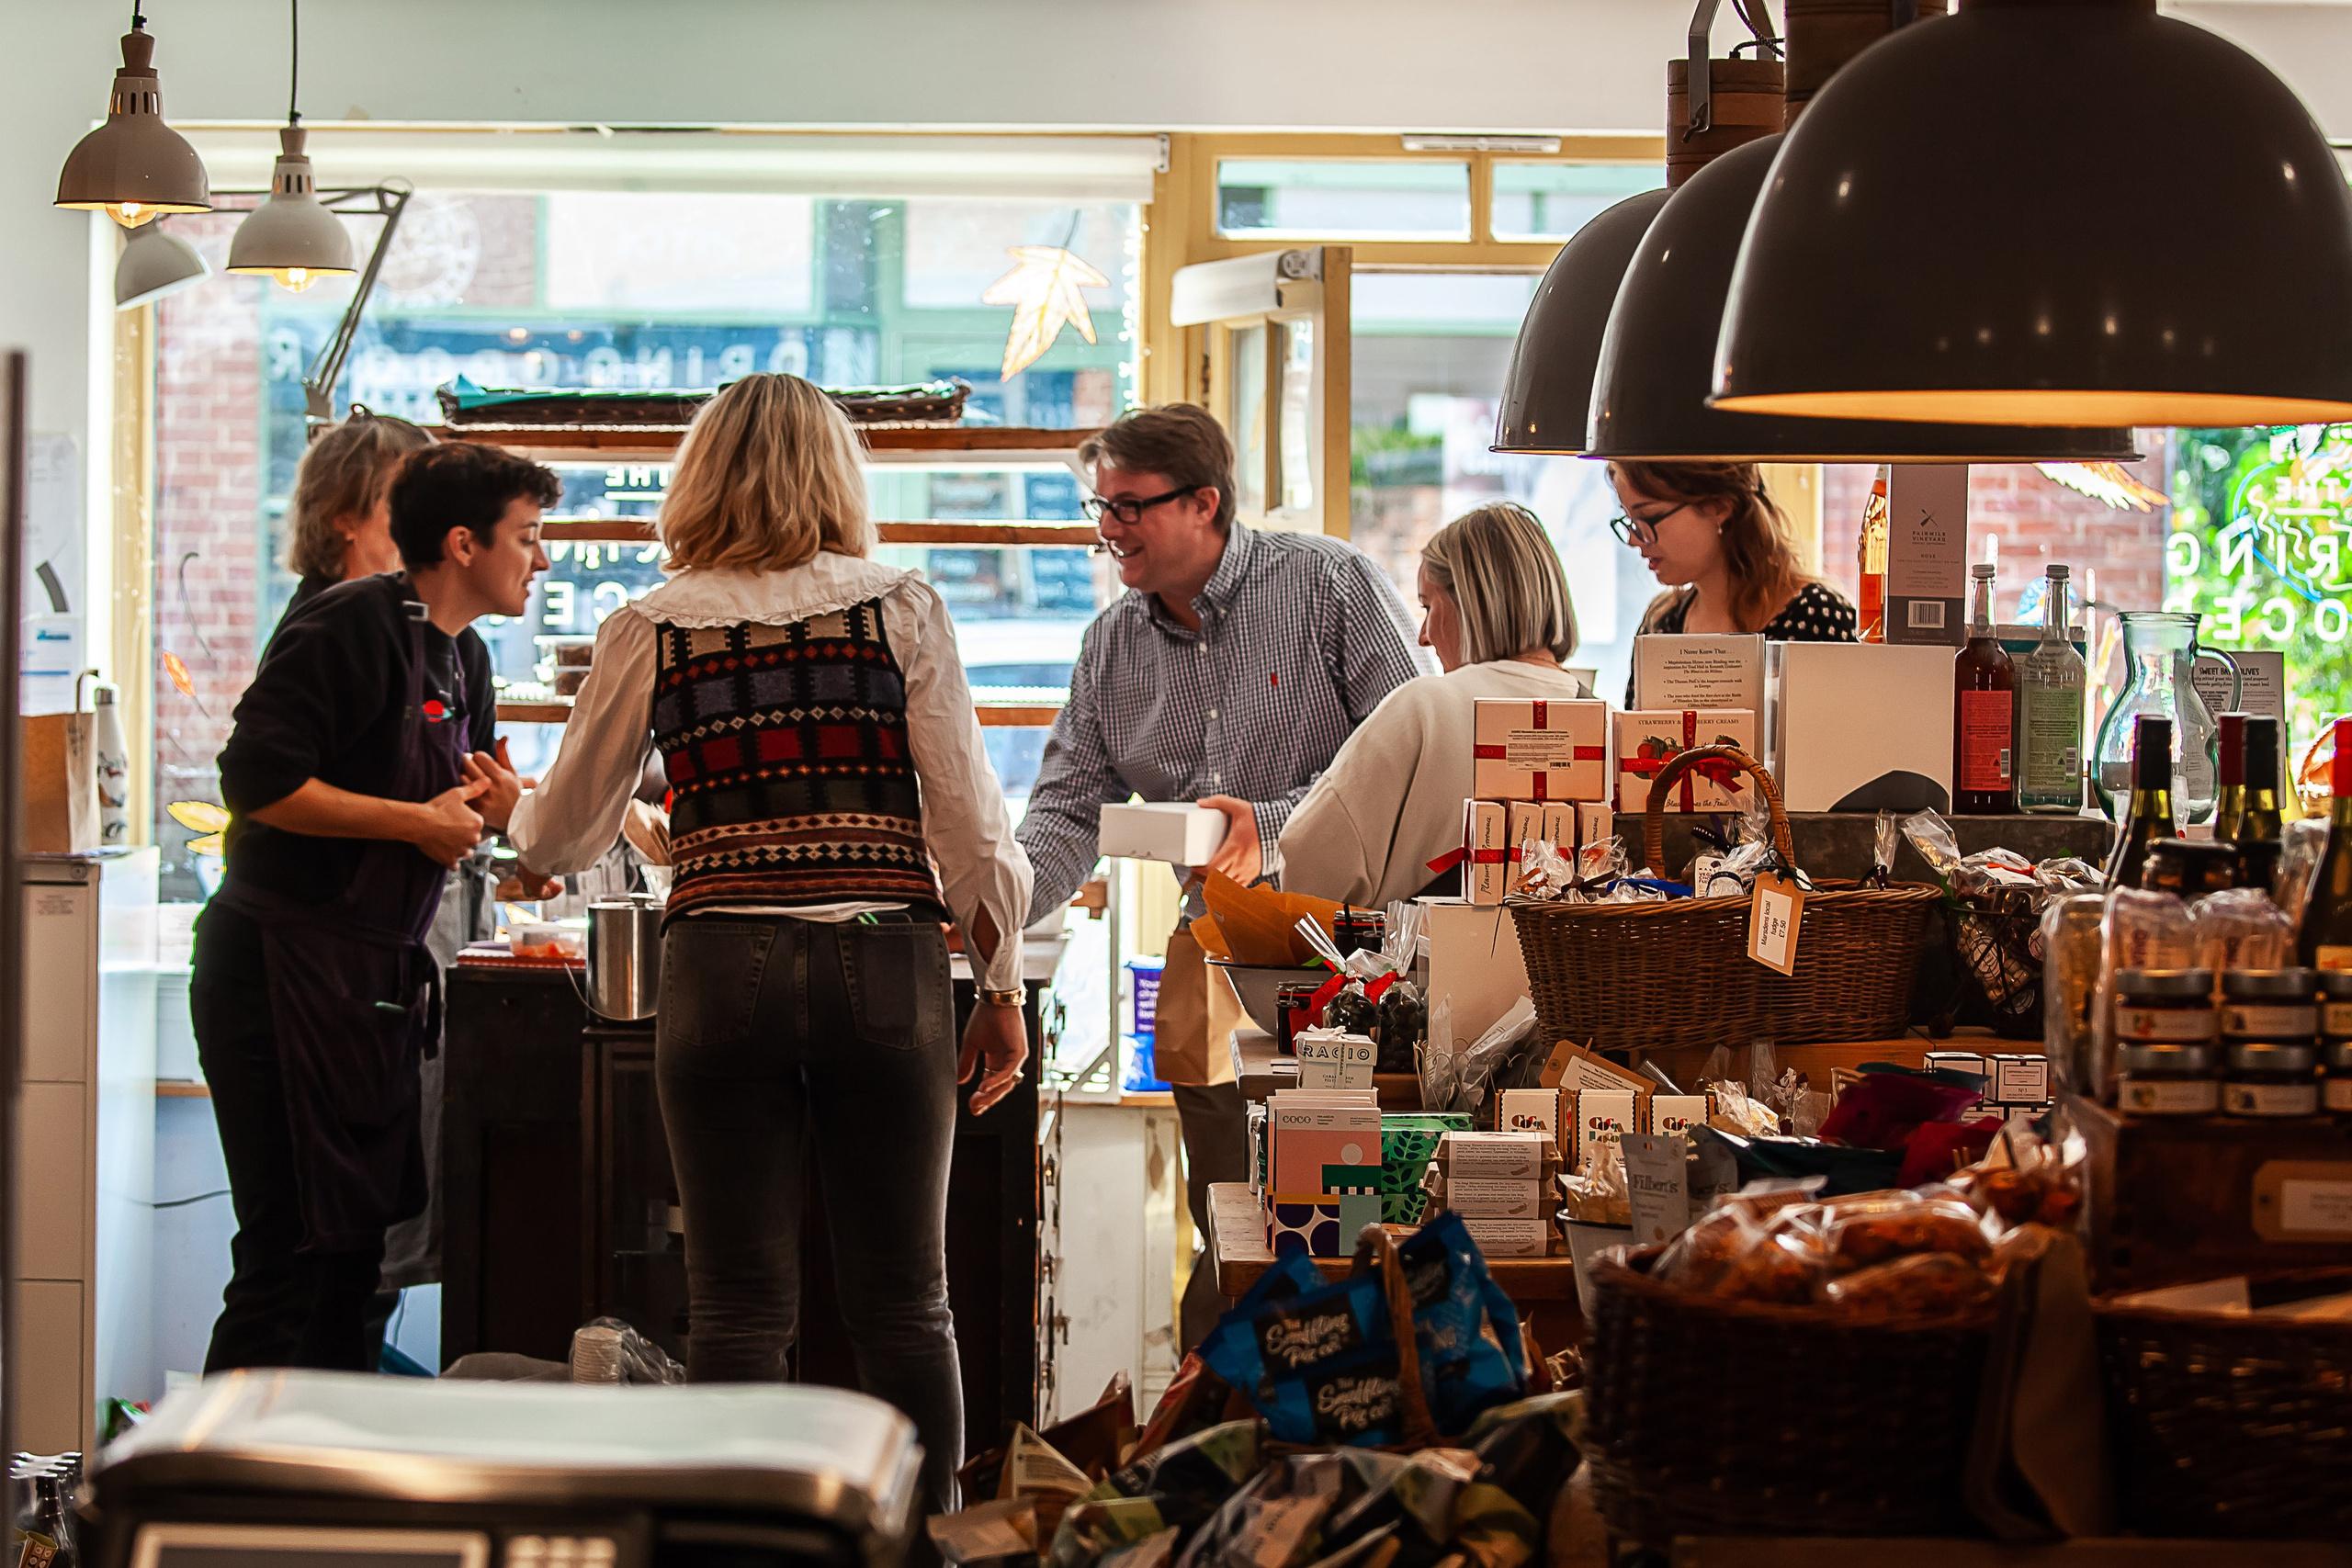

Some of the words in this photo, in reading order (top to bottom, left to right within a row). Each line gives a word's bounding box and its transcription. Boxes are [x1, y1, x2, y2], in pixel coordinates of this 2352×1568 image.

[2199, 667, 2220, 675] SWEET
[2220, 667, 2232, 675] BAS
[1761, 916, 1770, 945] Marsdens
[1770, 918, 1779, 935] fudge
[1779, 920, 1787, 938] £7.50
[1283, 1115, 1312, 1123] COCO
